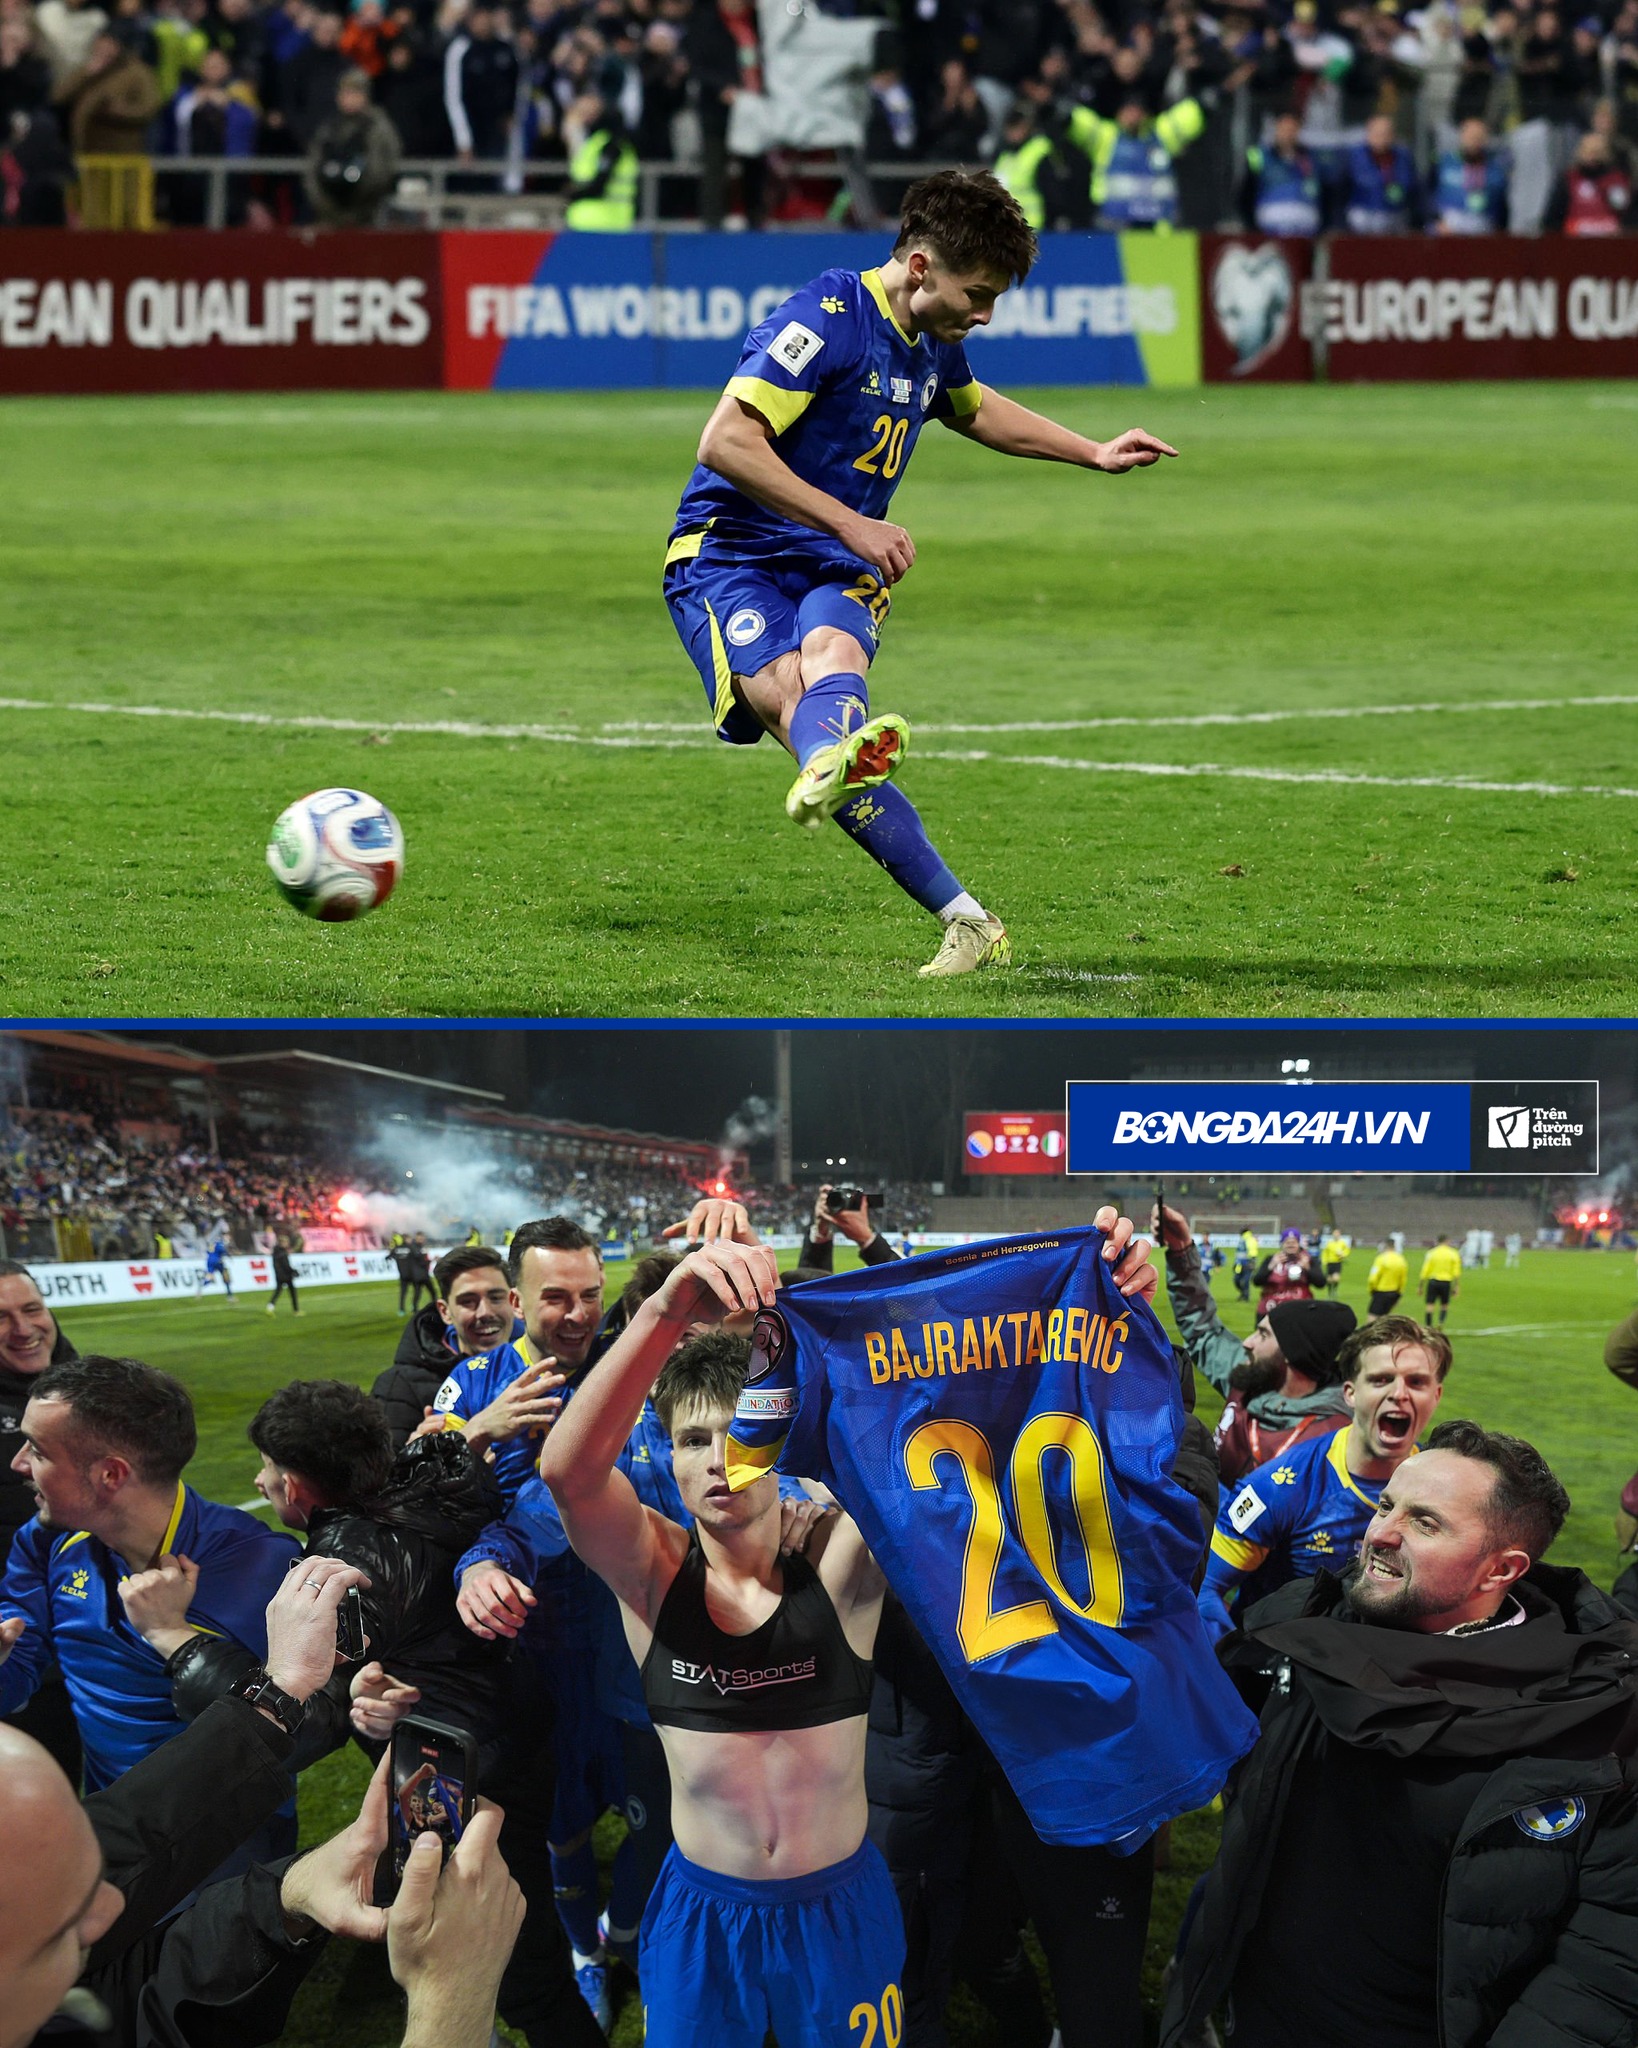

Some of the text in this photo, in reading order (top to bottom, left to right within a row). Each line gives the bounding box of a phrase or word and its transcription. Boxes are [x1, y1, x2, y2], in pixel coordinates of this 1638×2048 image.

[0, 278, 430, 348] EAN QUALIFIERS
[467, 284, 569, 338] FIFA
[570, 284, 744, 339] WORLD
[1301, 278, 1557, 342] EUROPEAN
[852, 414, 909, 479] 20
[841, 573, 891, 628] 20
[851, 805, 886, 834] KELME
[1026, 1134, 1040, 1154] 2
[945, 1239, 1060, 1266] Bosnia and Herzegovina
[863, 1307, 1132, 1386] BAJRAKTAREVIĆ
[904, 1411, 1125, 1665] 20
[1305, 1544, 1335, 1554] KELME
[61, 1585, 89, 1600] KELME
[672, 1657, 816, 1687] STATSports
[848, 1982, 903, 2048] 20
